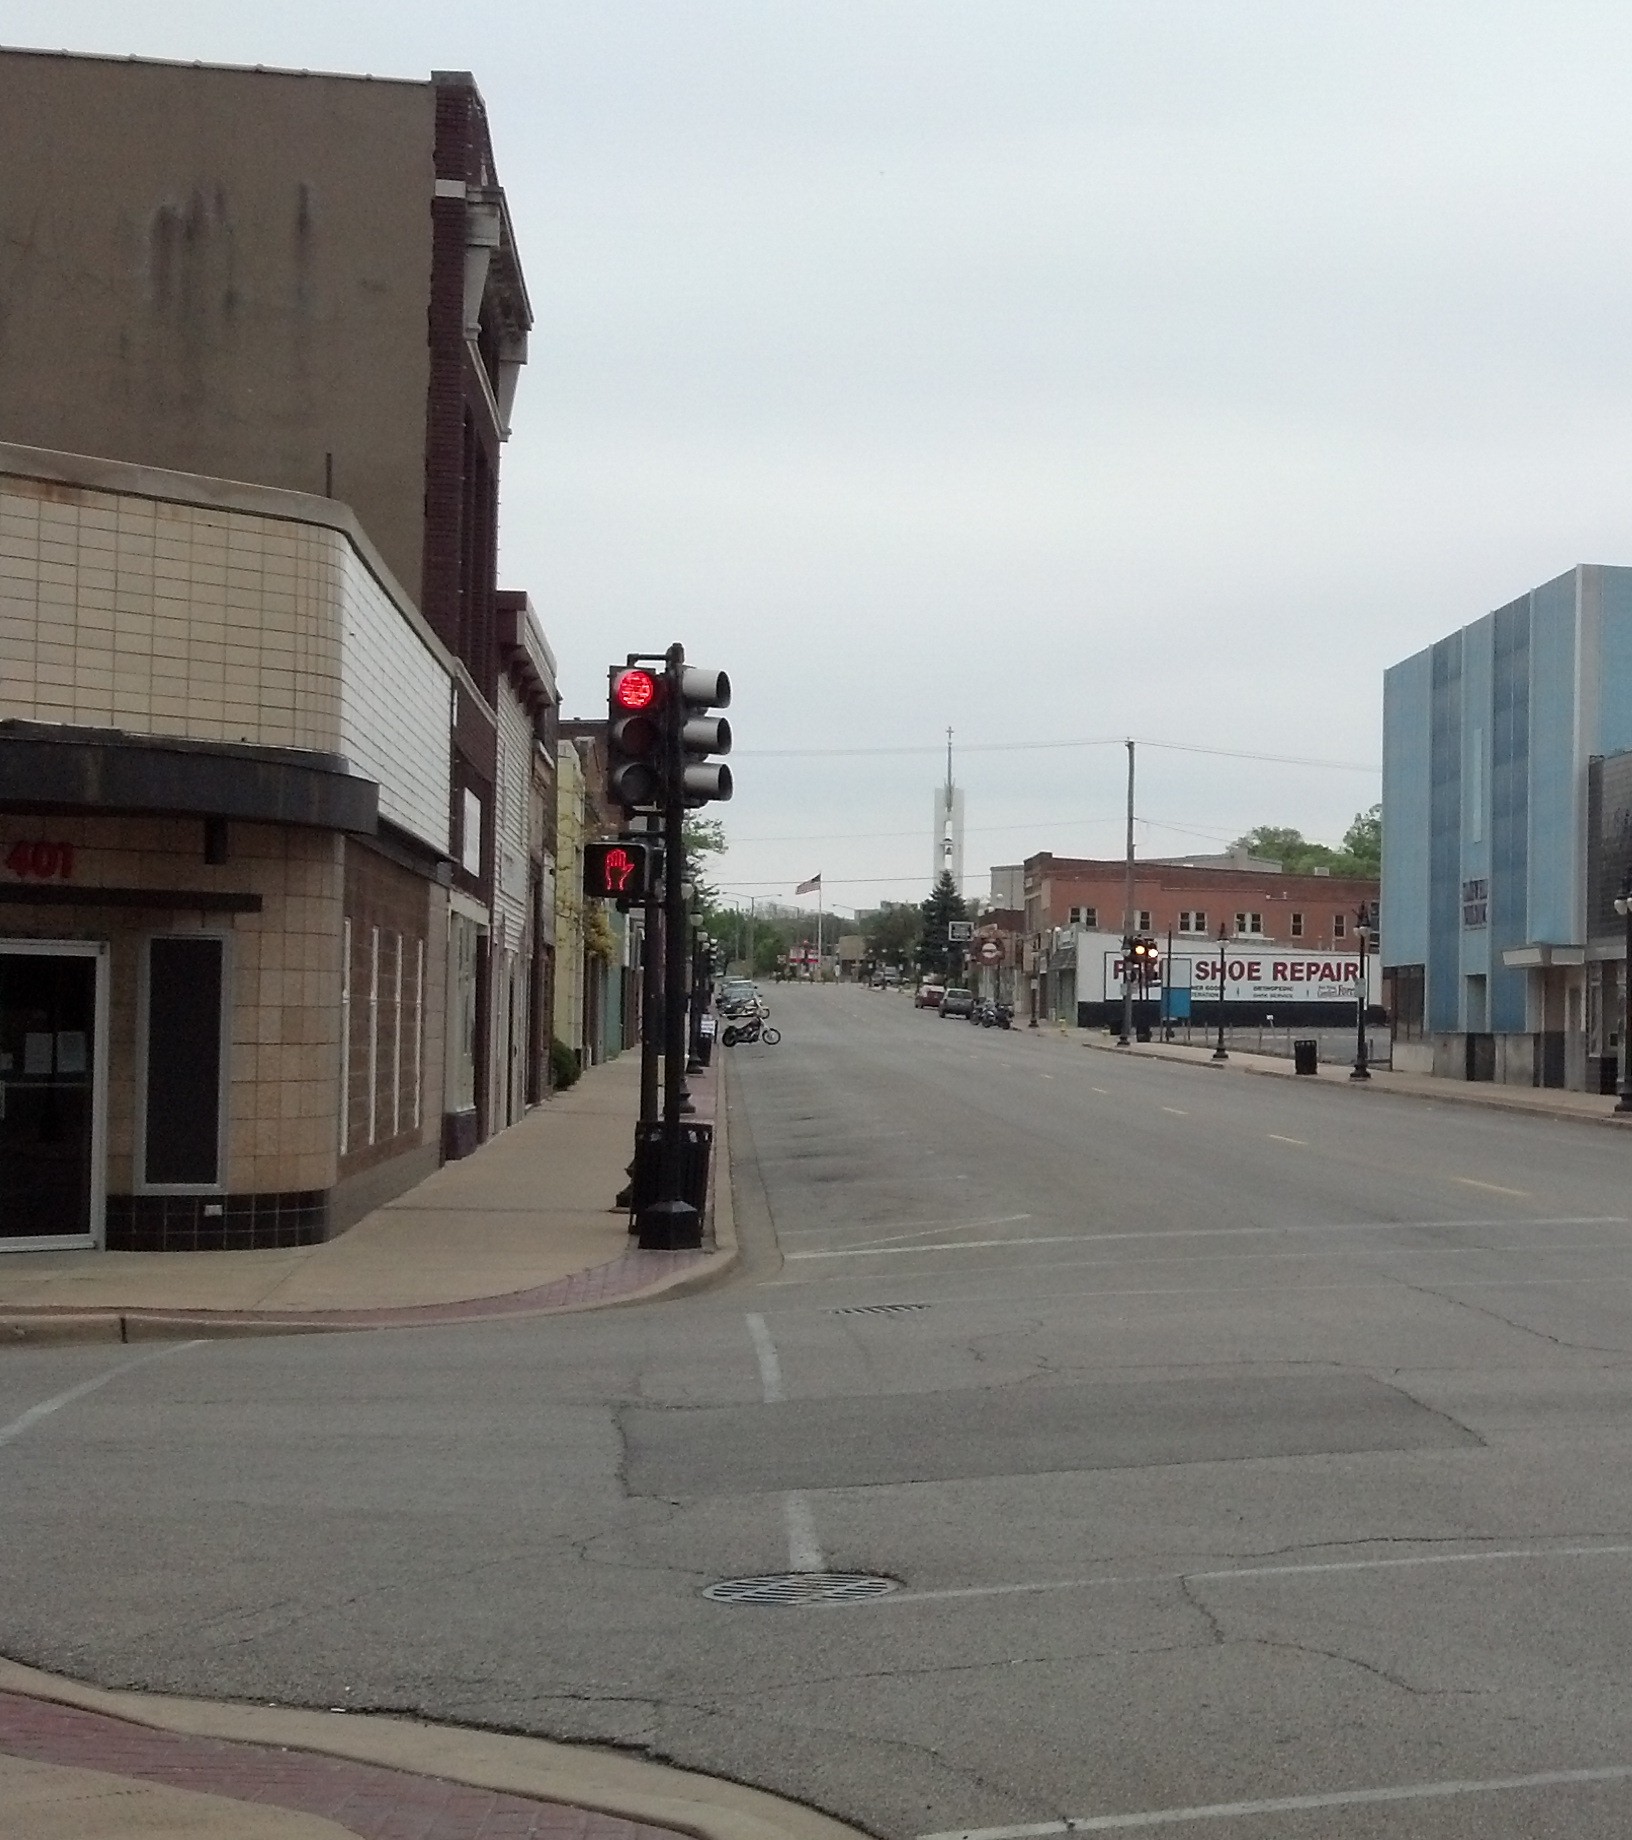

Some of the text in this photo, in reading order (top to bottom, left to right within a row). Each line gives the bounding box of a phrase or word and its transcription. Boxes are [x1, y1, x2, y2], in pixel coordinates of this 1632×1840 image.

[7, 842, 74, 878] 401
[1195, 960, 1360, 982] SHOE REPAIR
